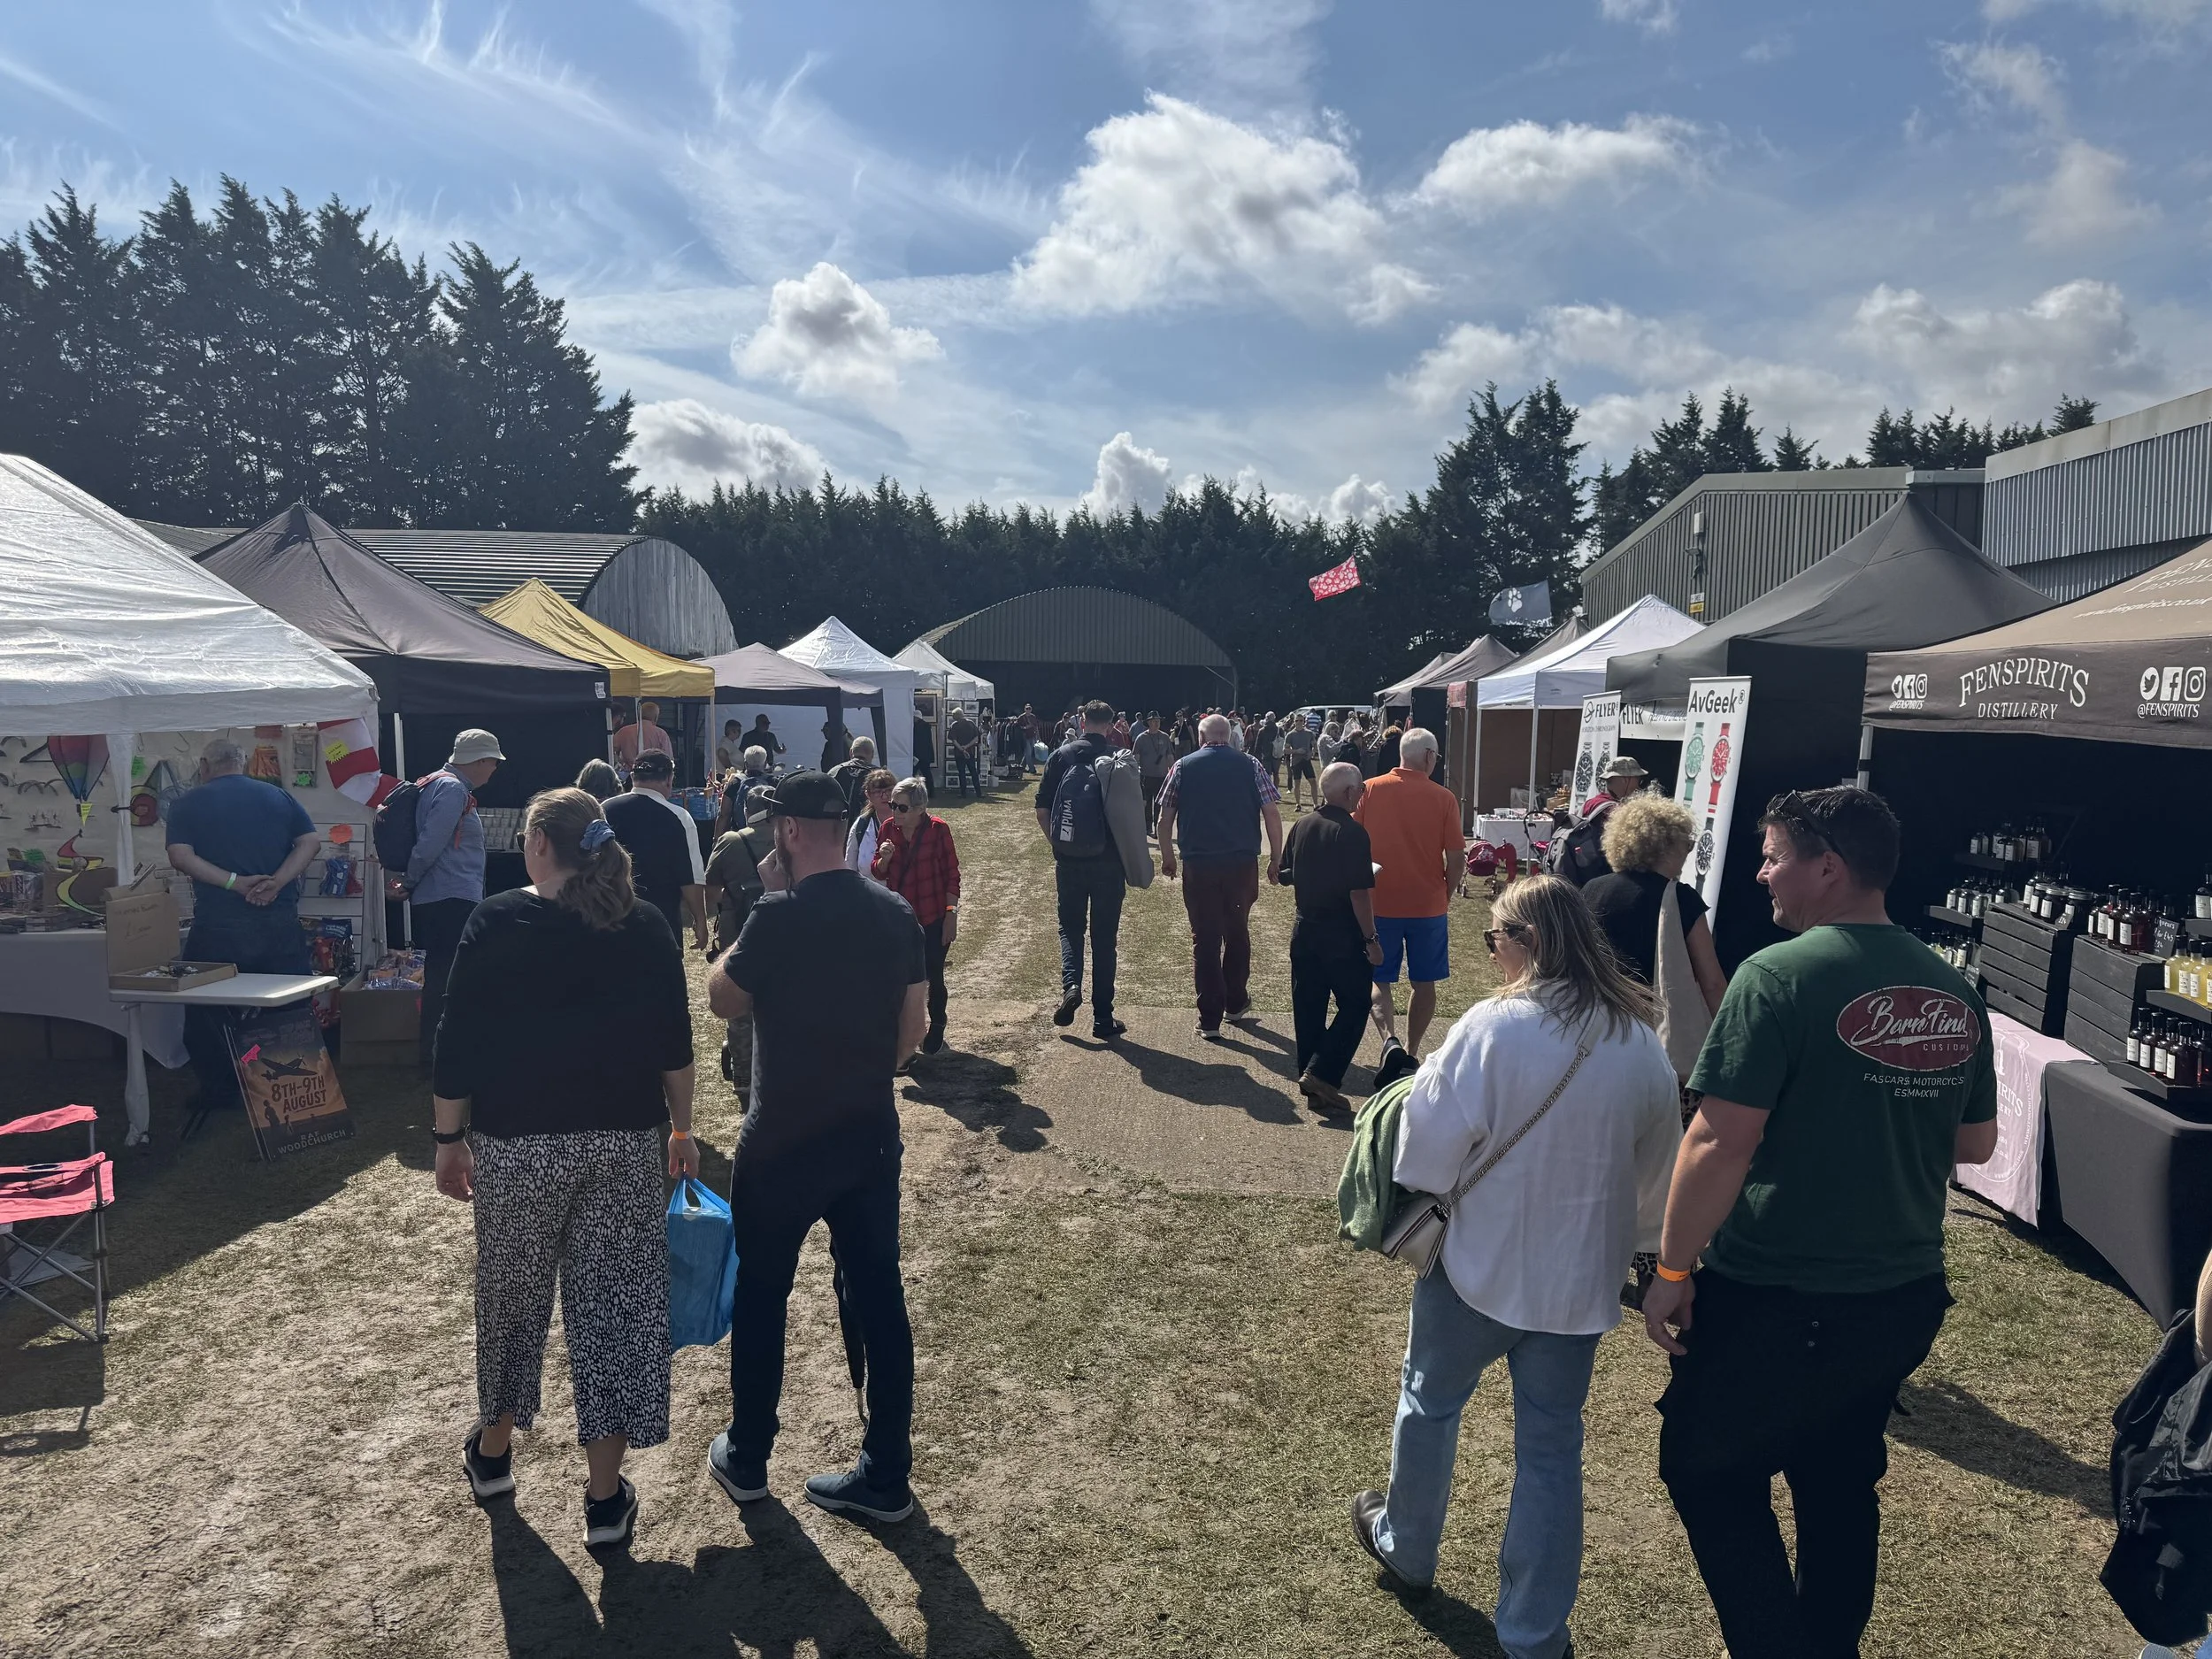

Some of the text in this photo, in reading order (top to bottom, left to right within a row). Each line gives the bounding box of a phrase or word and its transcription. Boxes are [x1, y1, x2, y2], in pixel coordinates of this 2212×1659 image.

[1959, 657, 2090, 708] FENSPIRITS
[1595, 702, 1616, 718] FLYER
[1888, 699, 1925, 711] @FENSPIRITS
[1978, 703, 2058, 720] DISTILLERY
[2137, 703, 2200, 719] @FENSPIRITS
[1062, 799, 1073, 826] PUMA
[283, 1089, 326, 1114] AUGUST
[1997, 1080, 2023, 1117] IRITS
[277, 1129, 346, 1155] WOODCHURCH
[301, 1130, 320, 1141] RAF
